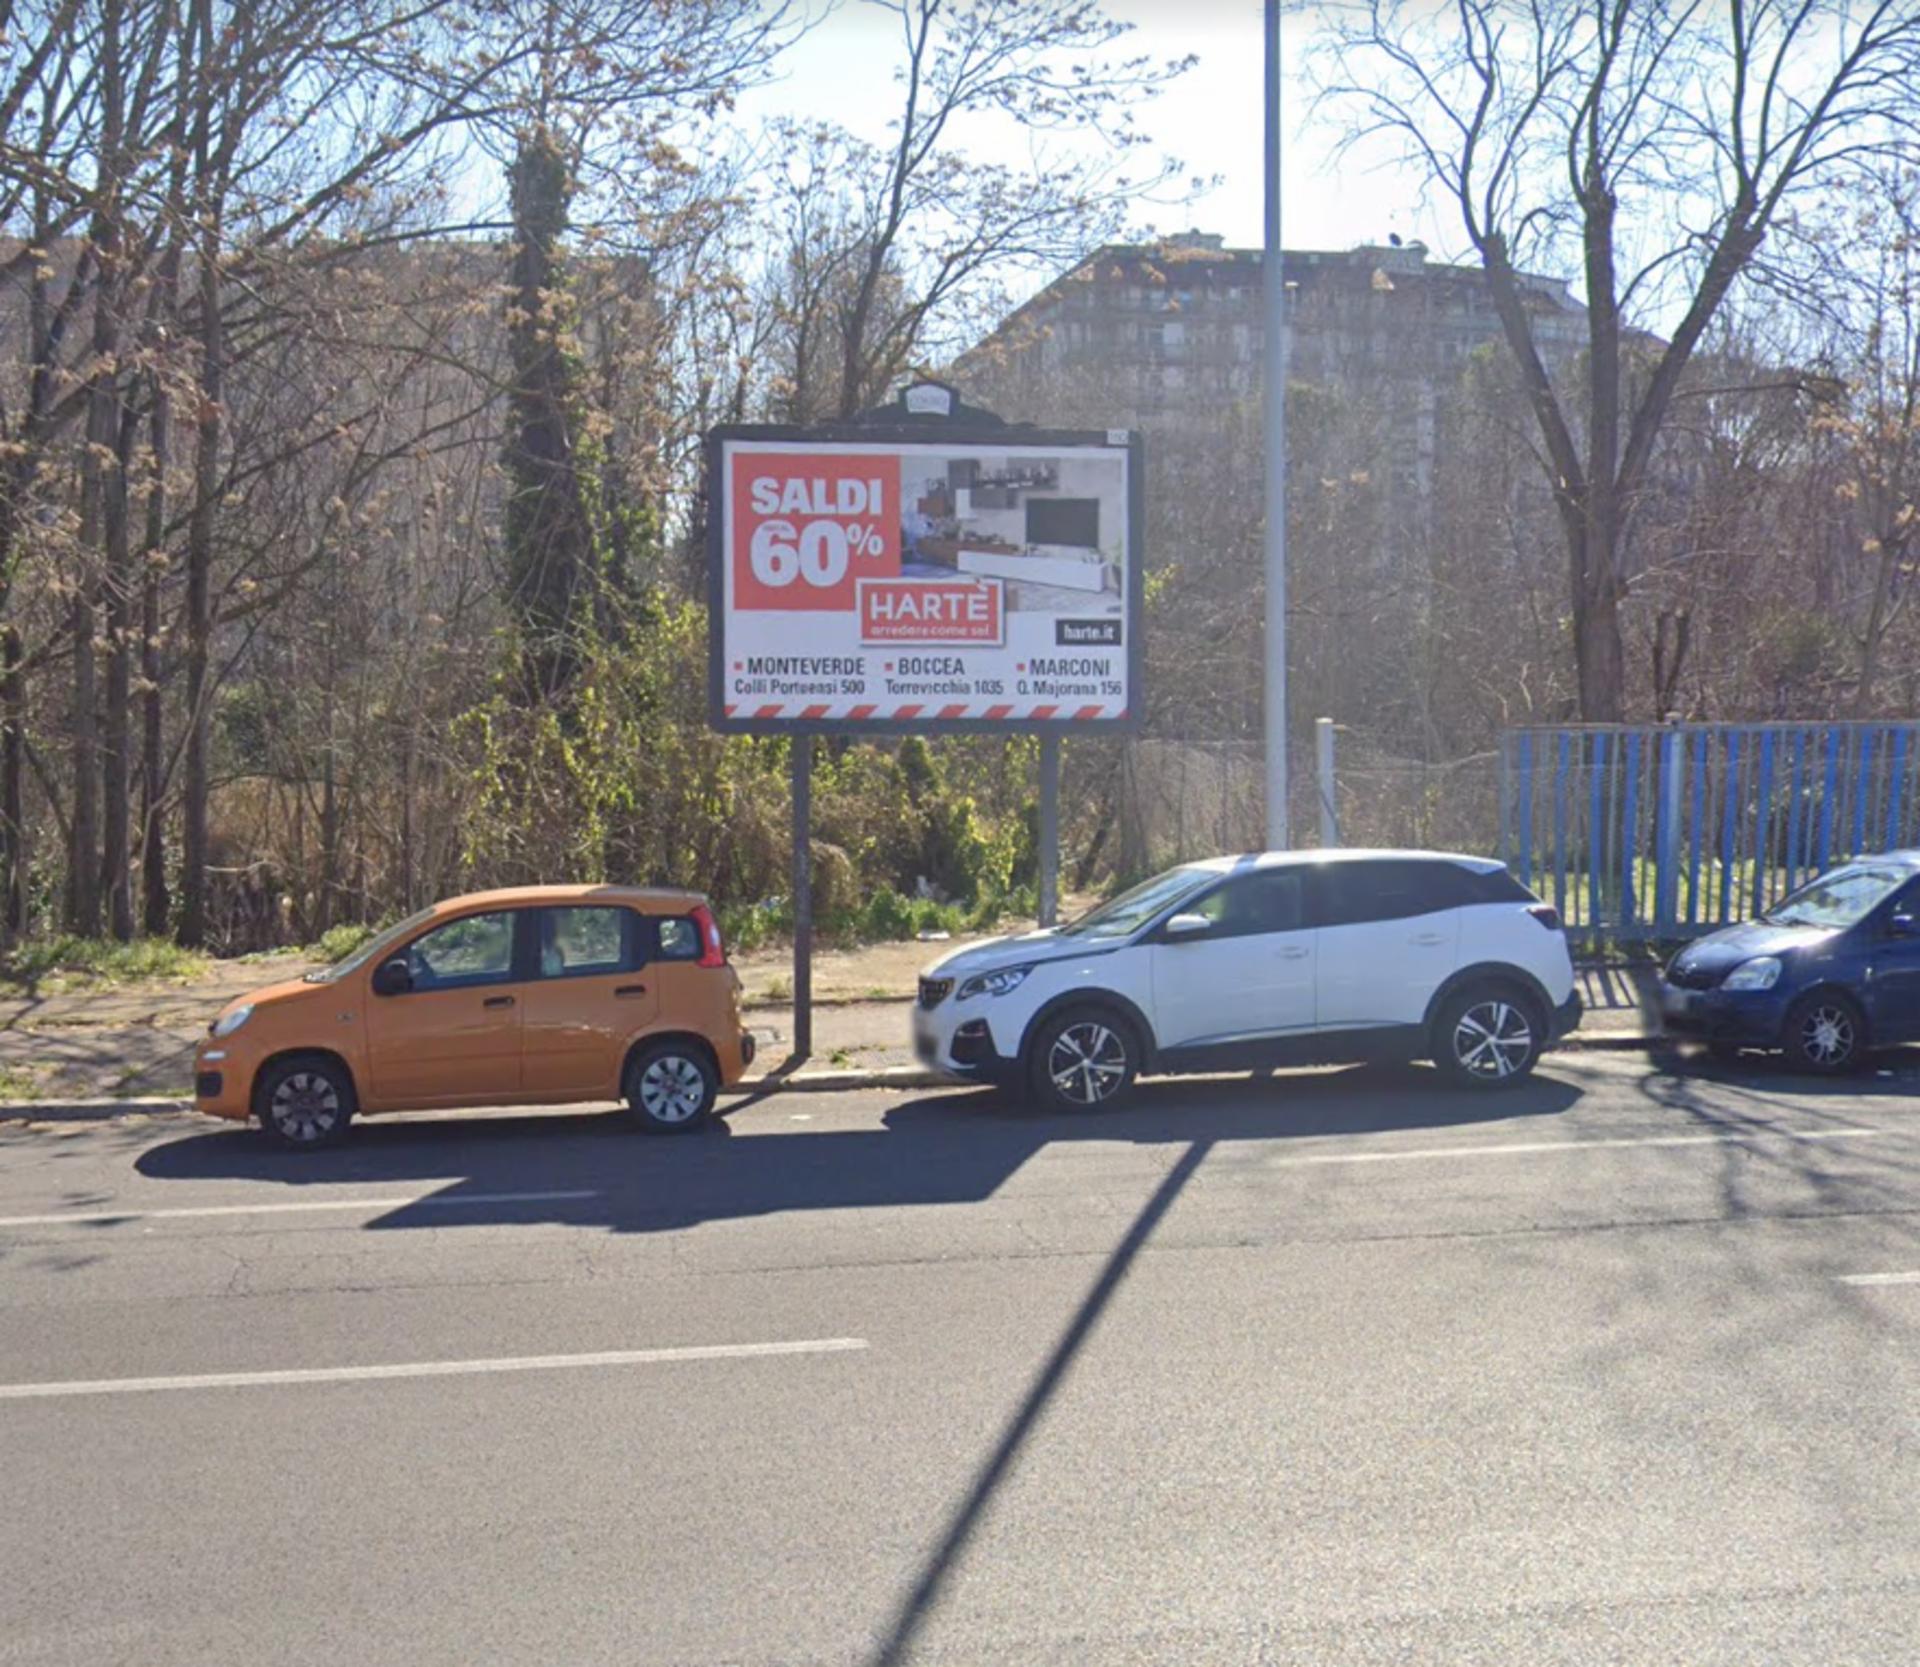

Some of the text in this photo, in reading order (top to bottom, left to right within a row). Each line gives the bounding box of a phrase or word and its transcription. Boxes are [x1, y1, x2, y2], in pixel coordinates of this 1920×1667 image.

[751, 477, 882, 515] SALDI
[750, 519, 884, 587] 60%
[1063, 624, 1116, 641] harte.it
[747, 656, 866, 675] MONTEVERDE
[897, 658, 965, 676] BOCCEA
[1029, 659, 1111, 677] MARCONI
[734, 679, 866, 695] Colli Portuensi 500
[974, 680, 1004, 695] 1035
[1033, 681, 1097, 698] Majorana
[1100, 681, 1122, 696] 156
